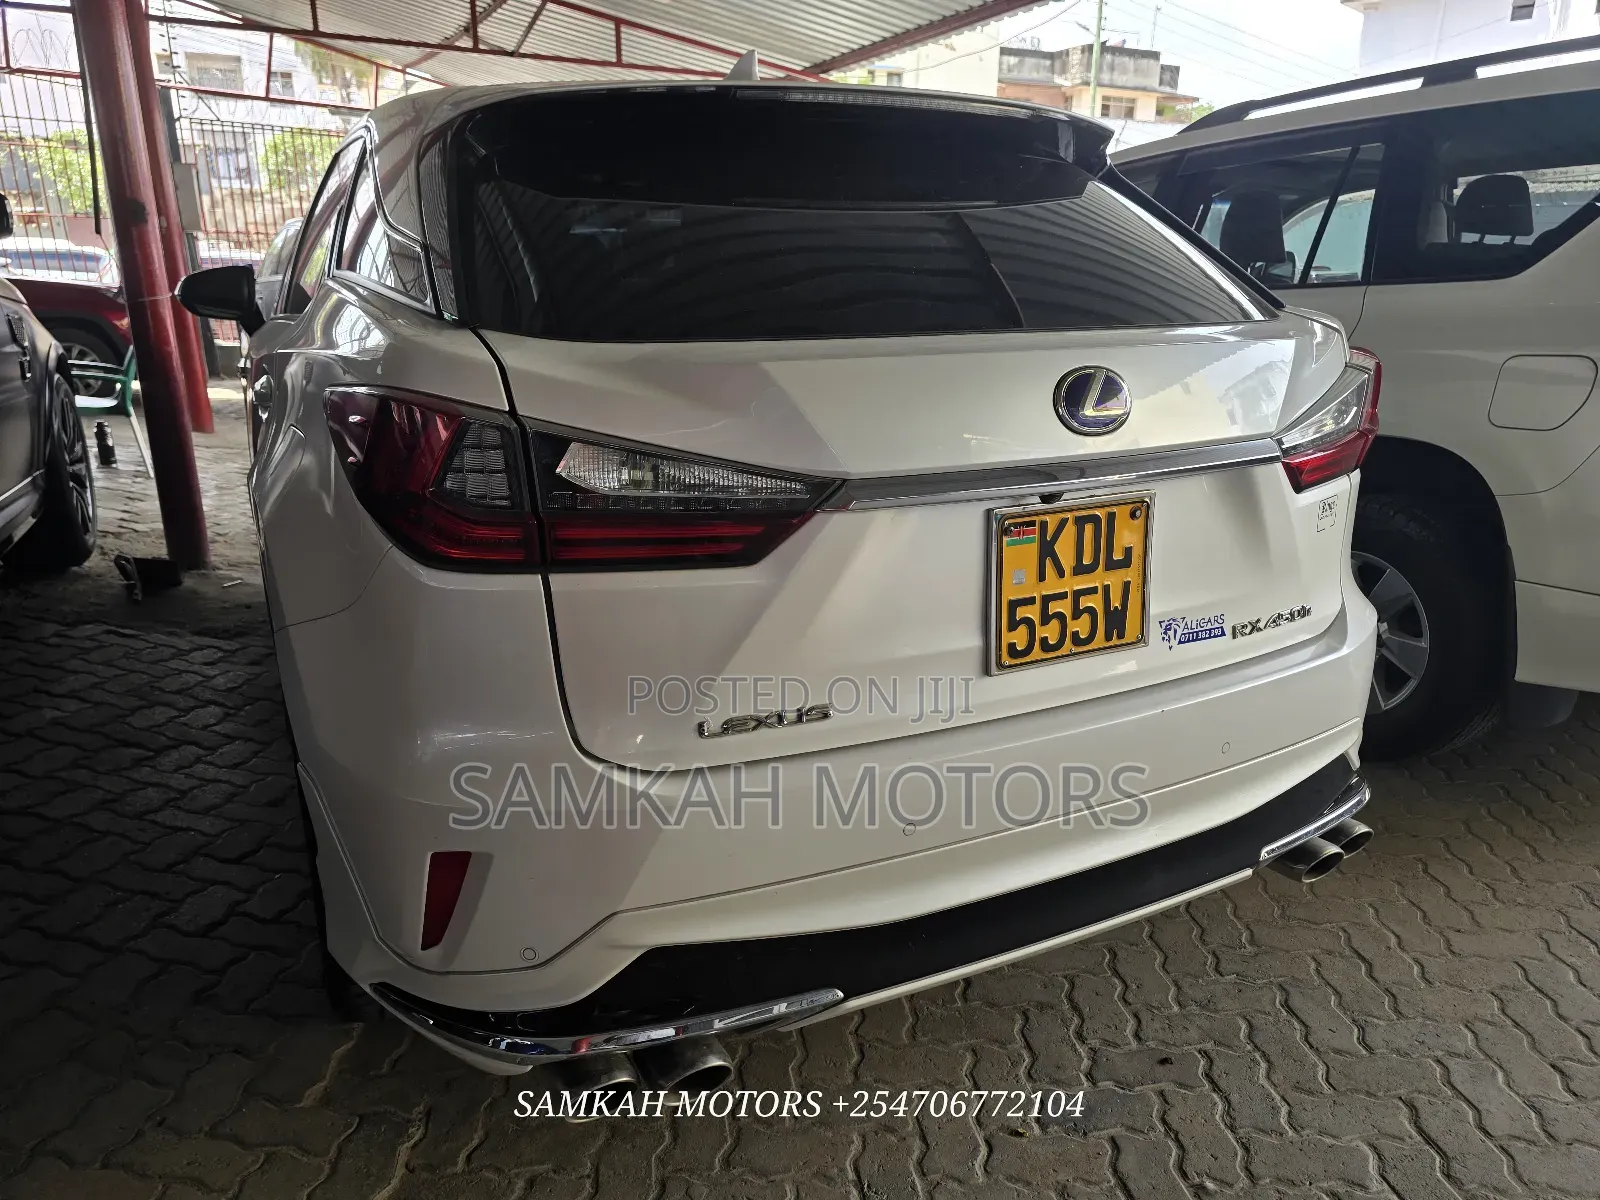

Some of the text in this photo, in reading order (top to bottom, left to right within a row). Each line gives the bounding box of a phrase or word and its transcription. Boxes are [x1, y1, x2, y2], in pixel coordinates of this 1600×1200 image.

[1038, 509, 1133, 583] KDL
[1007, 580, 1131, 659] 555W
[1180, 628, 1222, 642] 0711 382 393
[1231, 617, 1263, 640] RX
[698, 703, 834, 739] LEXUS
